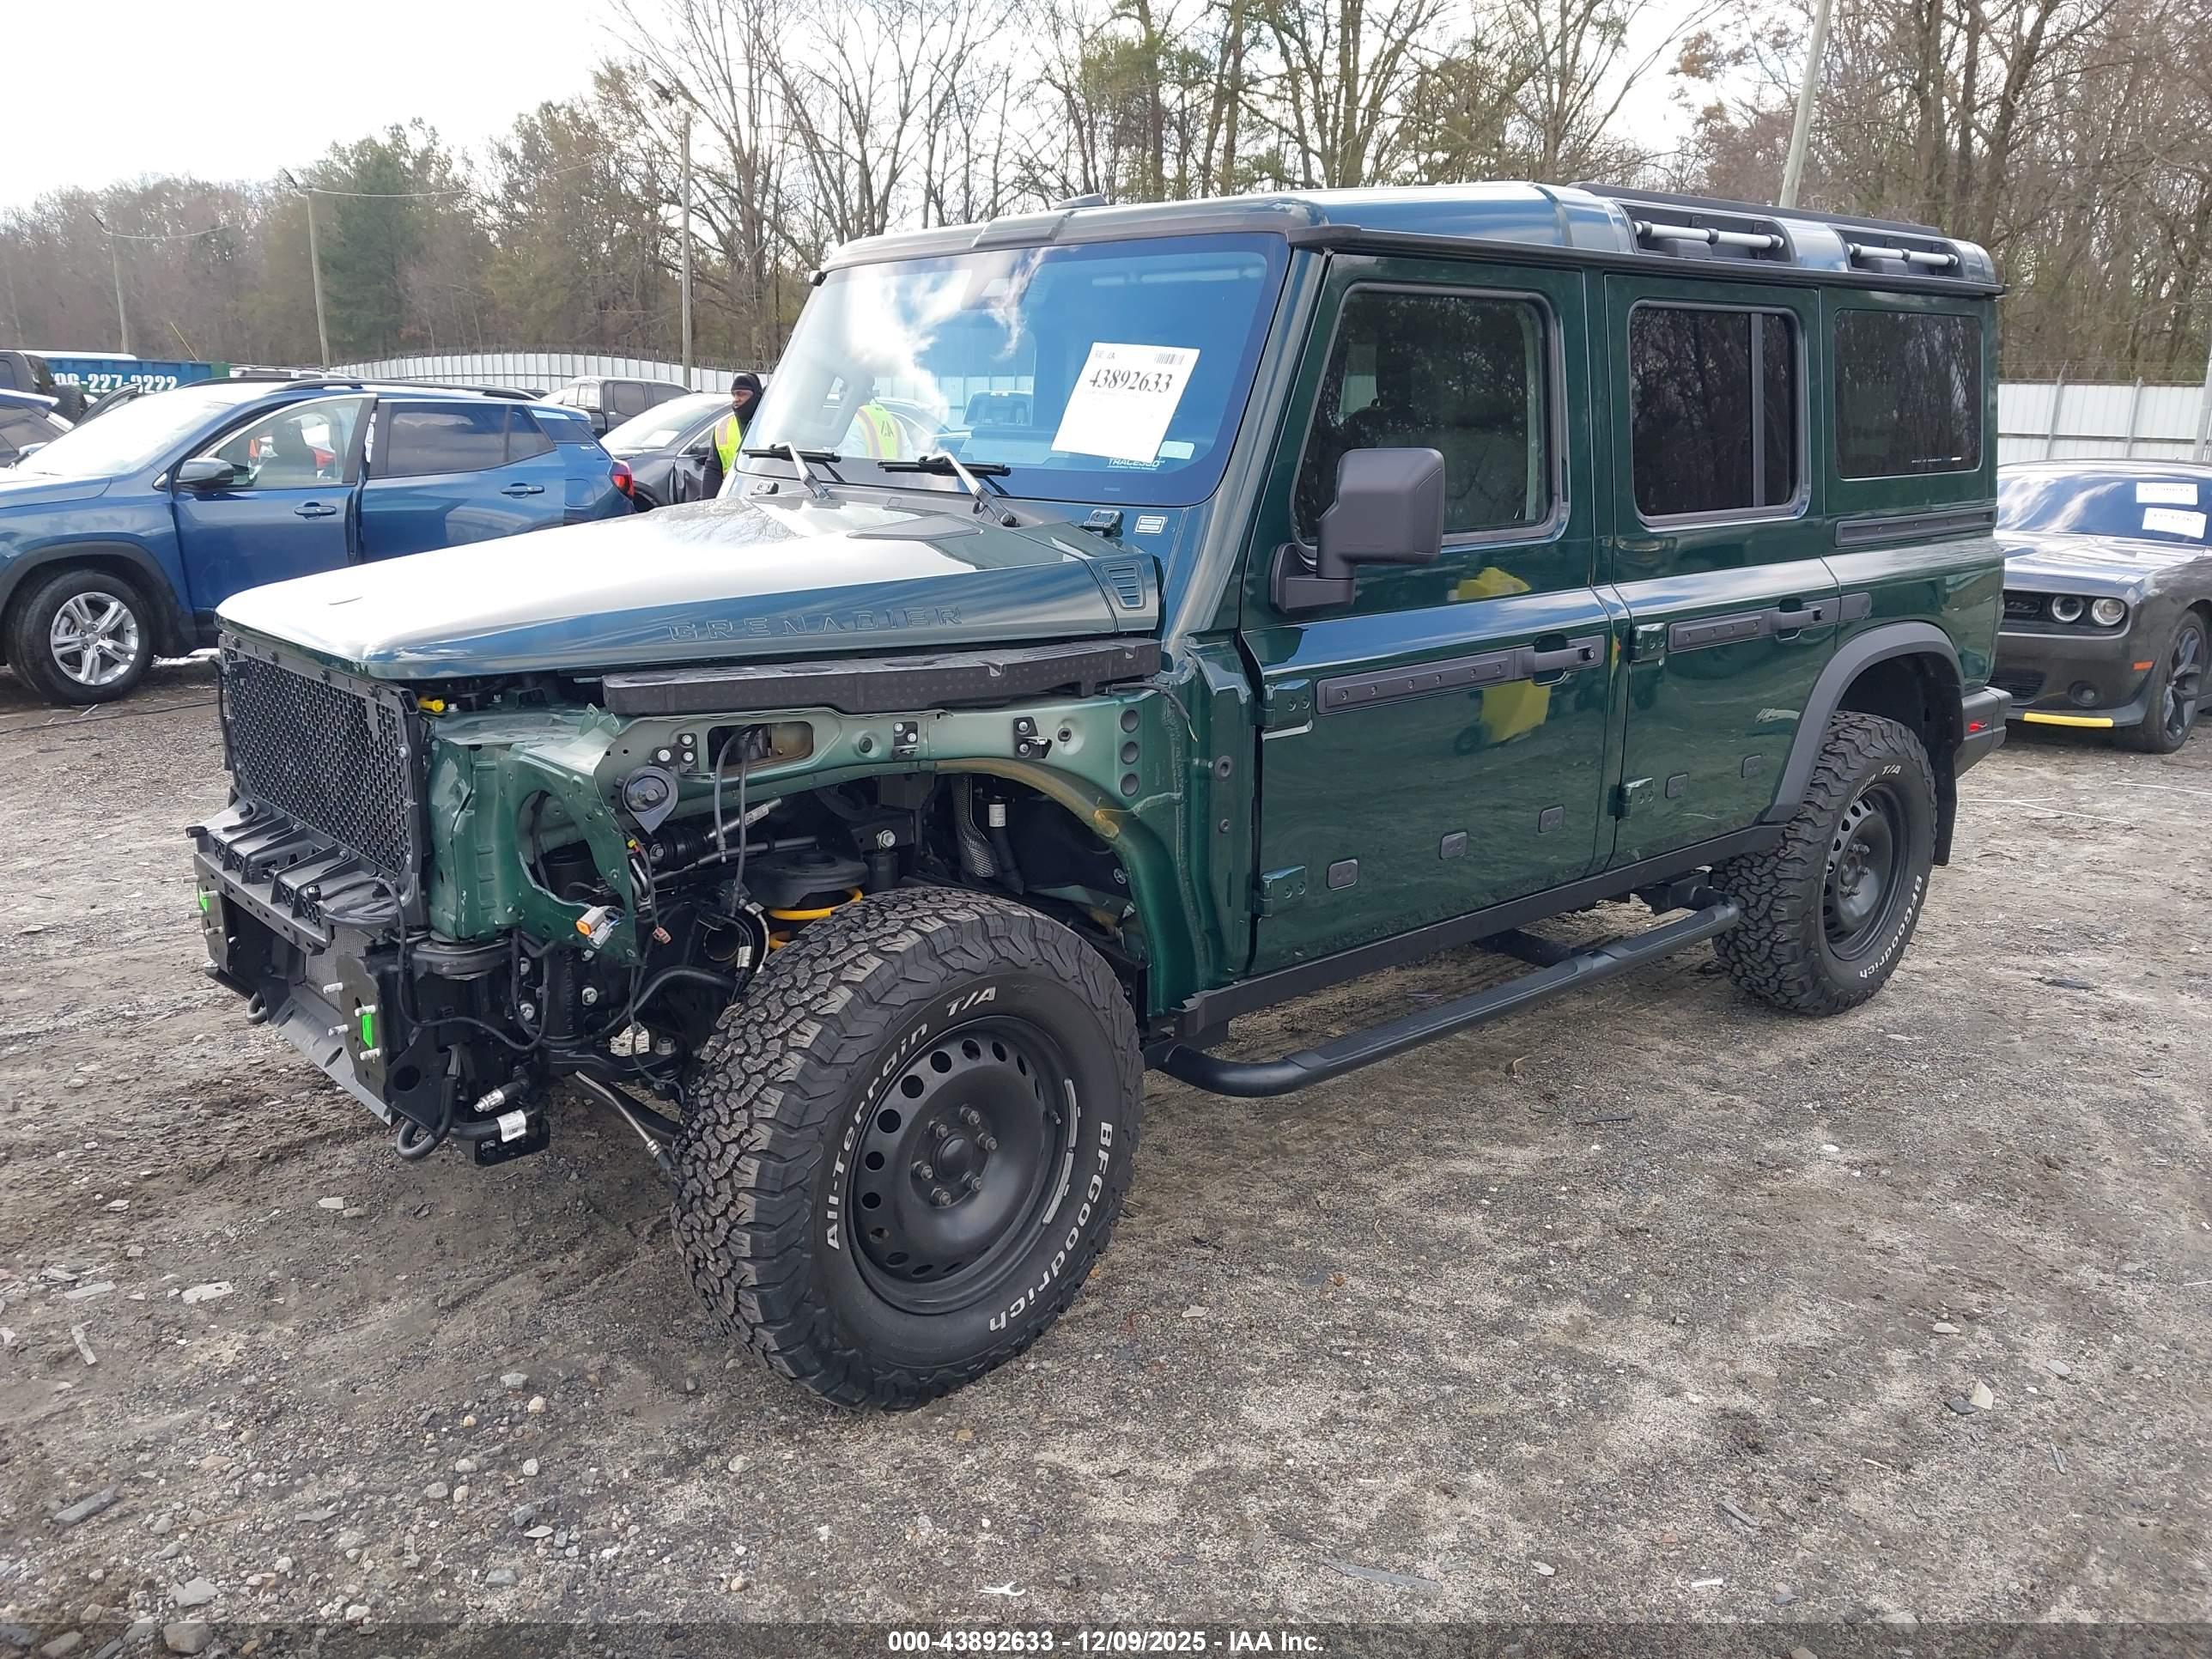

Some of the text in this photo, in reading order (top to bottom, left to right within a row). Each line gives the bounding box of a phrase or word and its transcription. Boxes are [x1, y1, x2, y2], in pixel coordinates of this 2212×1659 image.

[50, 372, 178, 394] 06-227-3222
[1090, 368, 1173, 393] 43892633
[668, 605, 963, 641] GRENADIER
[1881, 763, 1902, 775] T/A
[1859, 874, 1923, 979] BFGoodrich
[826, 1022, 929, 1250] All-Terrain
[945, 986, 997, 1018] T/A
[989, 1121, 1114, 1334] BFGoodrich
